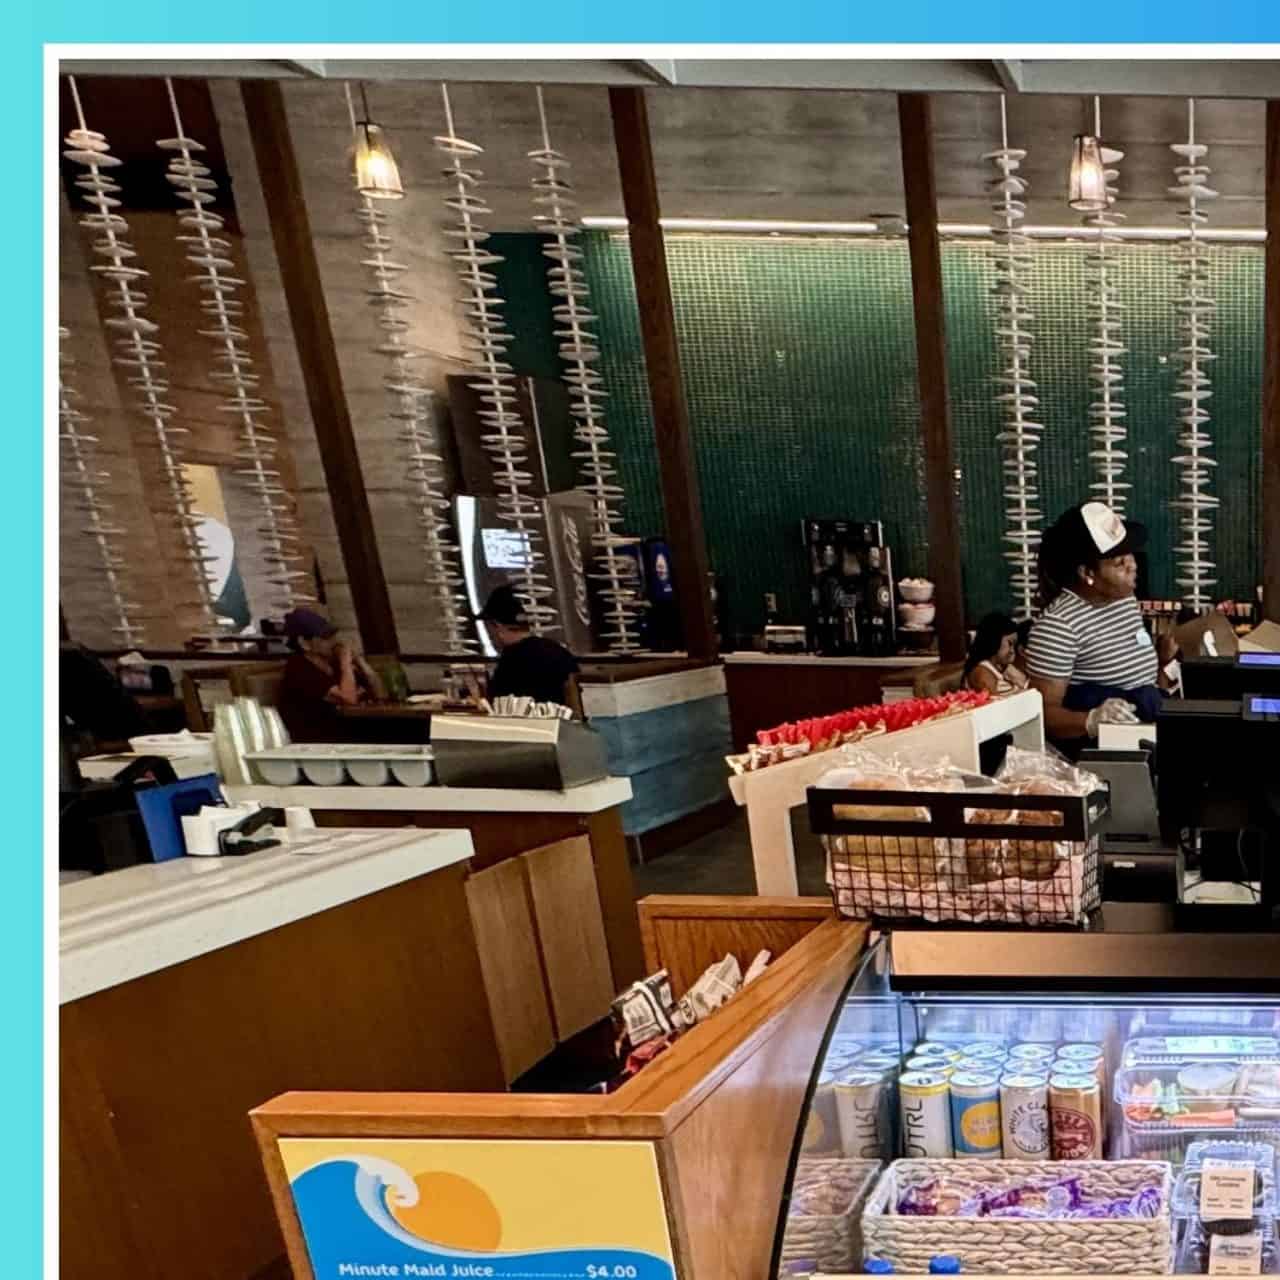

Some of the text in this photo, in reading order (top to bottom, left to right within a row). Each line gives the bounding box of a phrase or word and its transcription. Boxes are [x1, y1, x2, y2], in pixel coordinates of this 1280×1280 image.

[906, 1099, 927, 1157] UTRL
[338, 1263, 637, 1279] Minute Maid Juice $4.00
